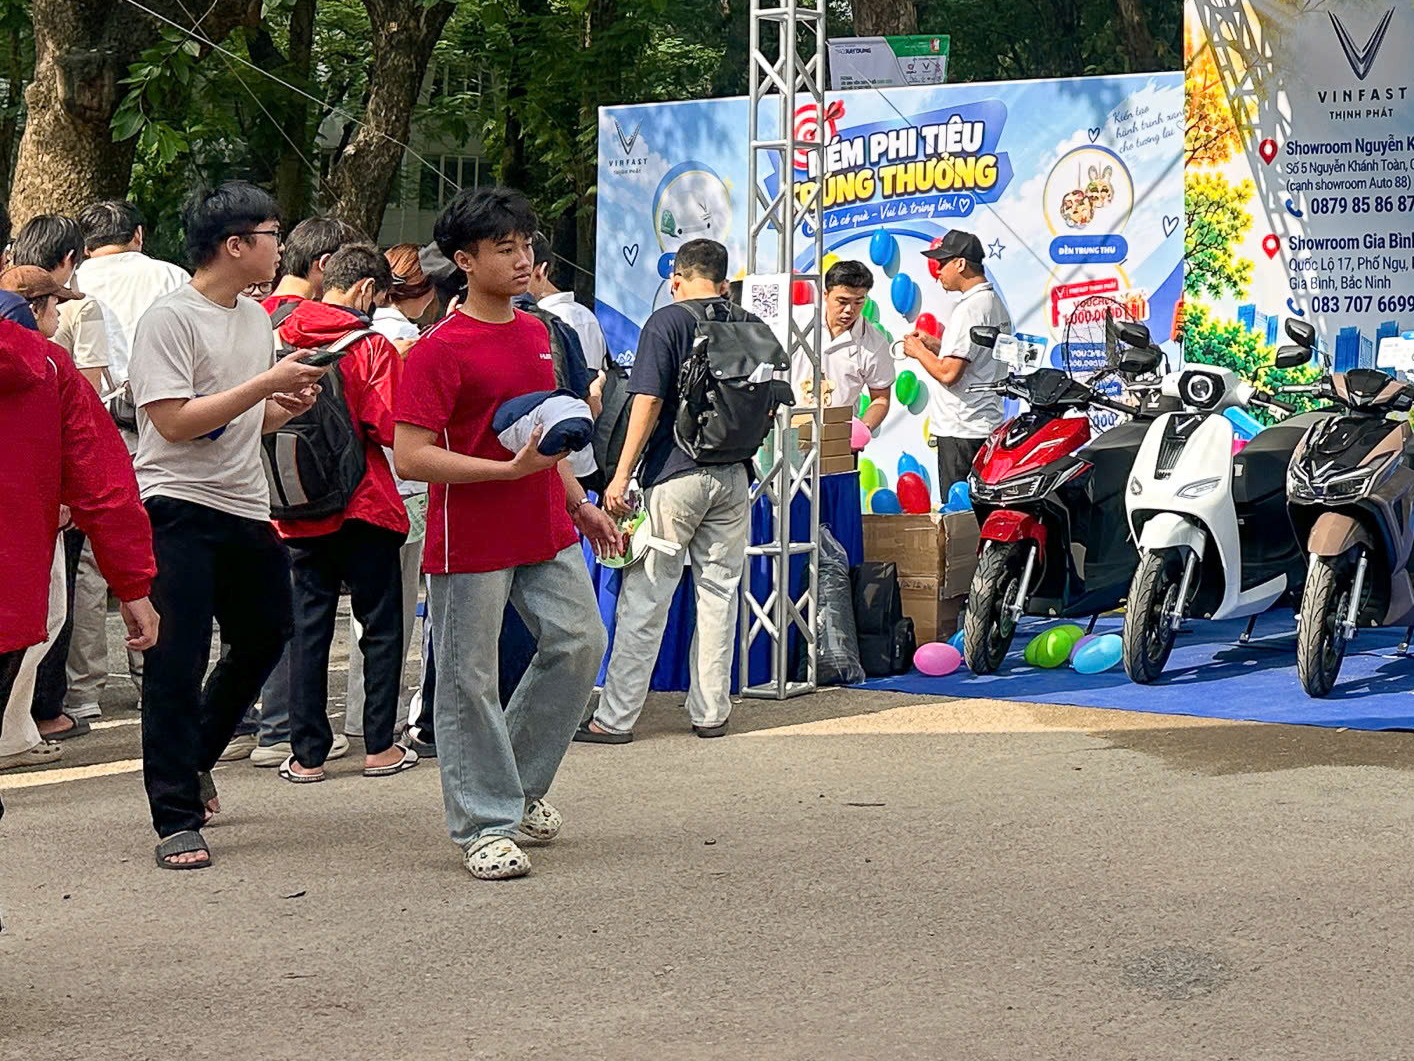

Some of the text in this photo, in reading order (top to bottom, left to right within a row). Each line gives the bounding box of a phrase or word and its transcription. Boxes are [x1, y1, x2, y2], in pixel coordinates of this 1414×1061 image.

[1318, 87, 1408, 103] VINFAST
[1329, 108, 1394, 122] THỊNH PHÁT
[870, 127, 917, 164] PHI
[921, 114, 984, 155] TIÊU
[1286, 140, 1352, 156] Showroom
[1355, 134, 1403, 156] Nguyễn
[609, 158, 648, 167] VINFAST
[1286, 160, 1300, 174] Số
[1301, 162, 1308, 173] 5
[1309, 159, 1346, 177] Nguyễn
[1348, 157, 1379, 172] Khánh
[1380, 158, 1408, 173] Toàn,
[877, 150, 998, 195] THƯỞNG
[1315, 178, 1367, 191] showroom
[1369, 177, 1393, 189] Auto
[1394, 175, 1412, 191] 88)
[1311, 197, 1347, 215] 0879
[1352, 196, 1370, 214] 85
[1374, 196, 1393, 213] 86
[1288, 236, 1360, 251] Showroom
[1363, 233, 1386, 249] Gia
[1289, 257, 1318, 272] Quốc
[1320, 256, 1335, 274] Lộ
[1338, 256, 1355, 272] 17,
[1357, 254, 1380, 270] Phố
[1383, 256, 1409, 273] Ngụ,
[1289, 274, 1391, 291] Gia Bình, Bắc Ninh
[1312, 296, 1340, 313] 083
[1344, 295, 1373, 313] 707
